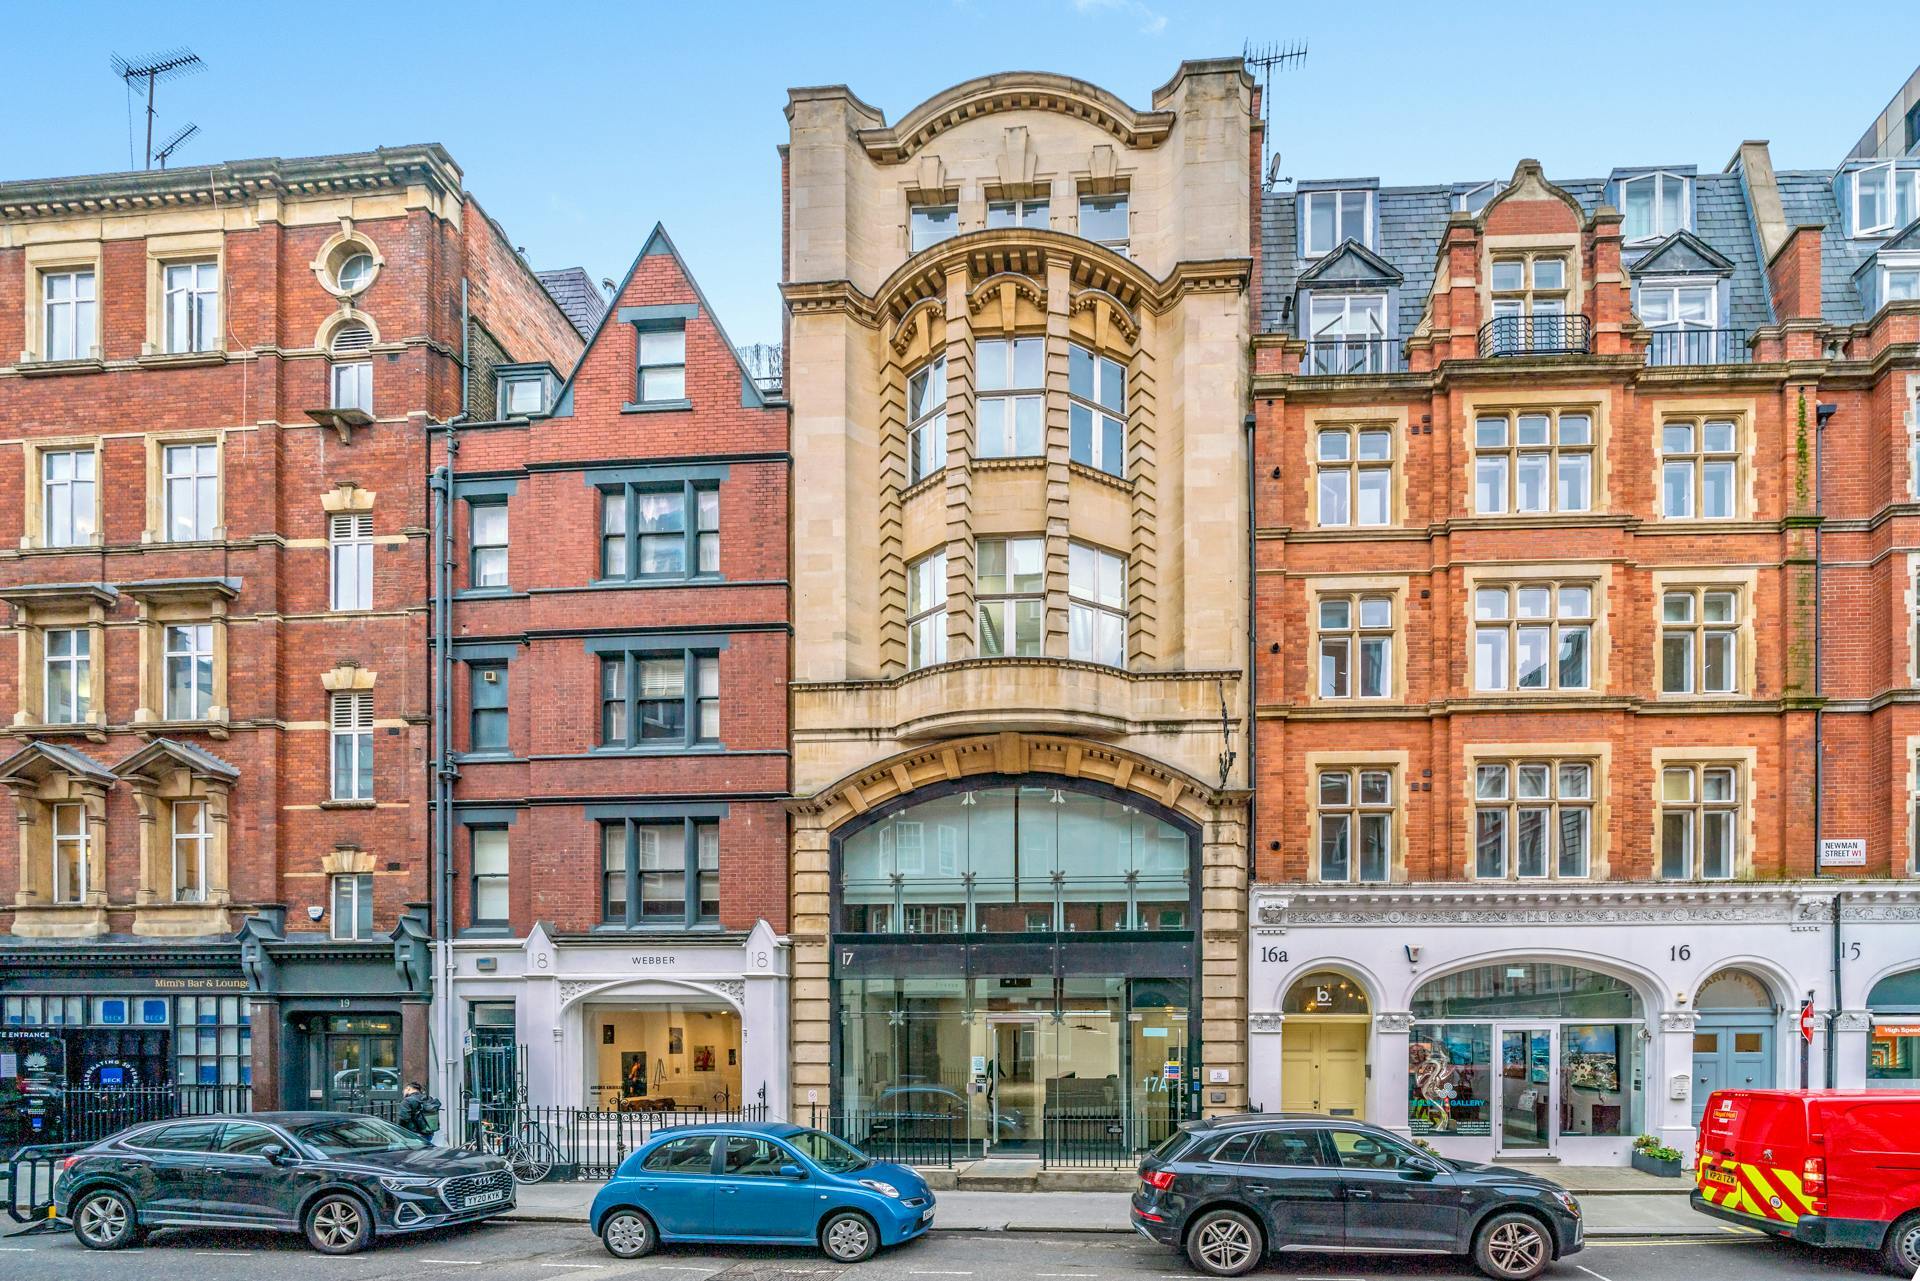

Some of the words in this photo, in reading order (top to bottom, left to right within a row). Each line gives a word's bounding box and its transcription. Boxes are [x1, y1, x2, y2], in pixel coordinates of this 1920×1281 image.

[751, 951, 769, 968] 18
[842, 952, 854, 966] 17
[1261, 946, 1289, 963] 16a
[1670, 944, 1691, 962] 16
[1842, 942, 1861, 961] 15
[531, 952, 548, 969] 18
[631, 956, 675, 965] WEBBER
[154, 979, 185, 988] Mimi's
[187, 979, 205, 988] Bar
[206, 979, 213, 988] &
[340, 999, 350, 1008] 19
[1143, 1076, 1168, 1093] 17A
[1450, 1099, 1485, 1107] GALLERY
